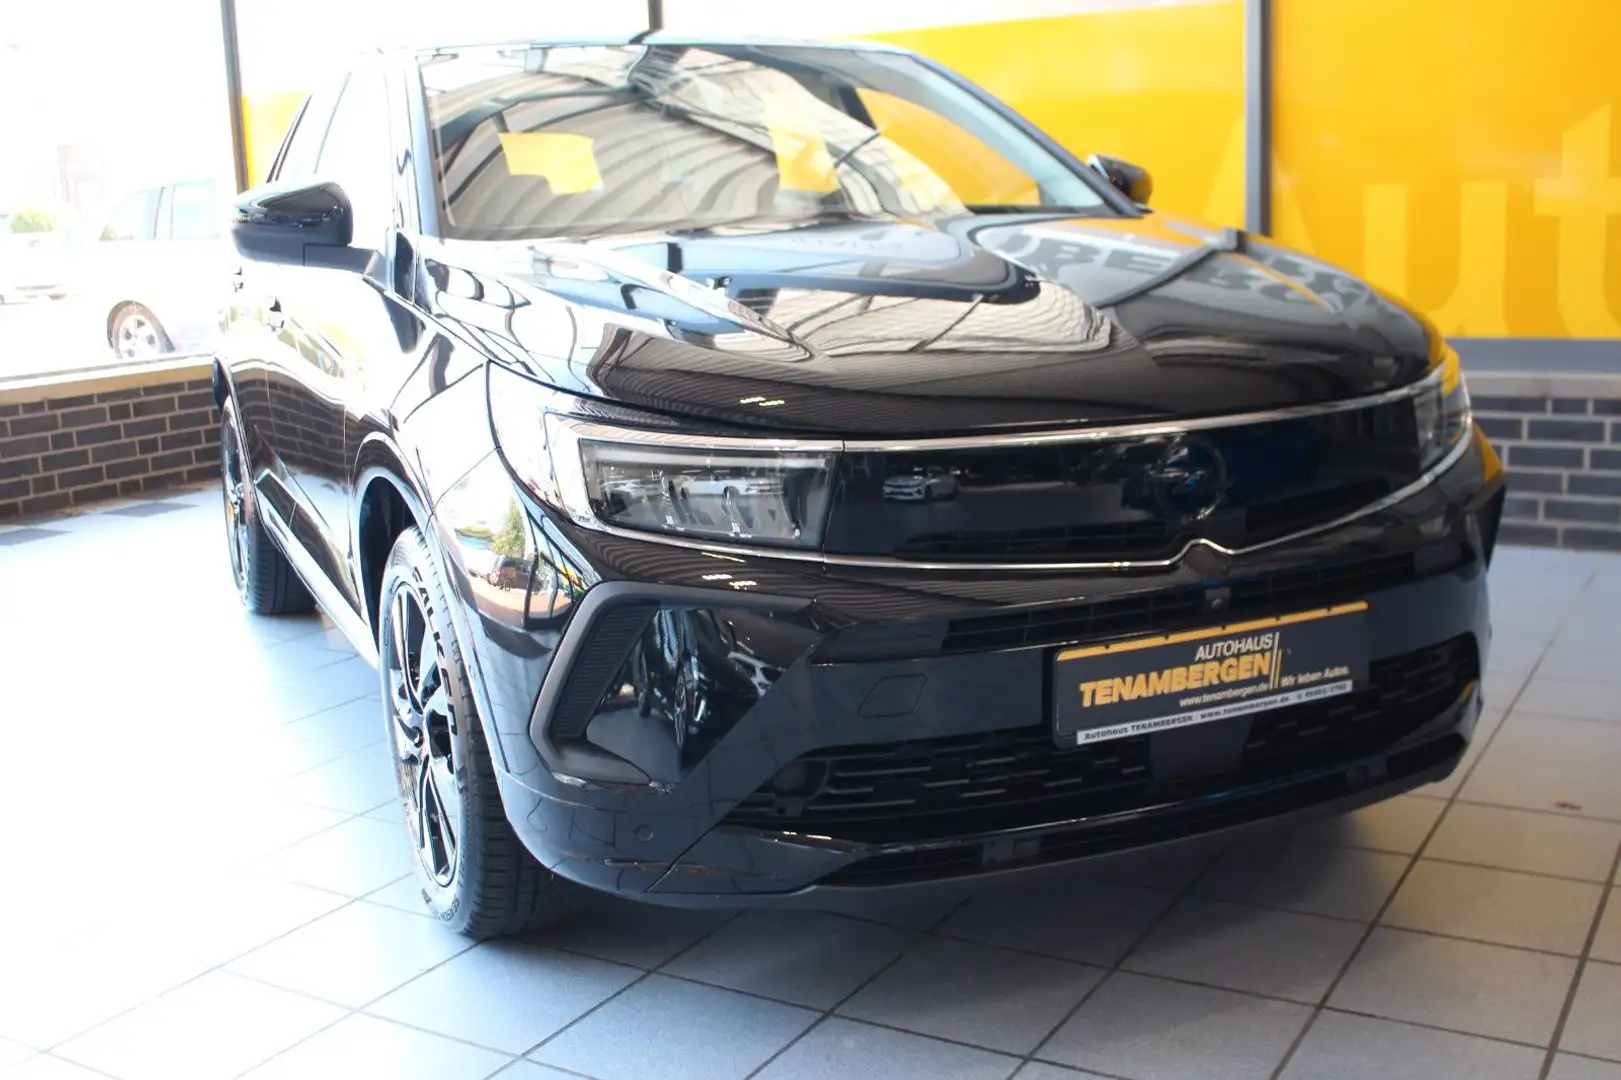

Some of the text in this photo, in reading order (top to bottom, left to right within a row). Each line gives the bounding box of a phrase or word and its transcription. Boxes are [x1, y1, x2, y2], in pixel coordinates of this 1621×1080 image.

[1193, 632, 1273, 662] AUTOHAUS
[1079, 651, 1272, 708] TENAMBERGEN
[1179, 682, 1269, 708] www.tenambergen.de
